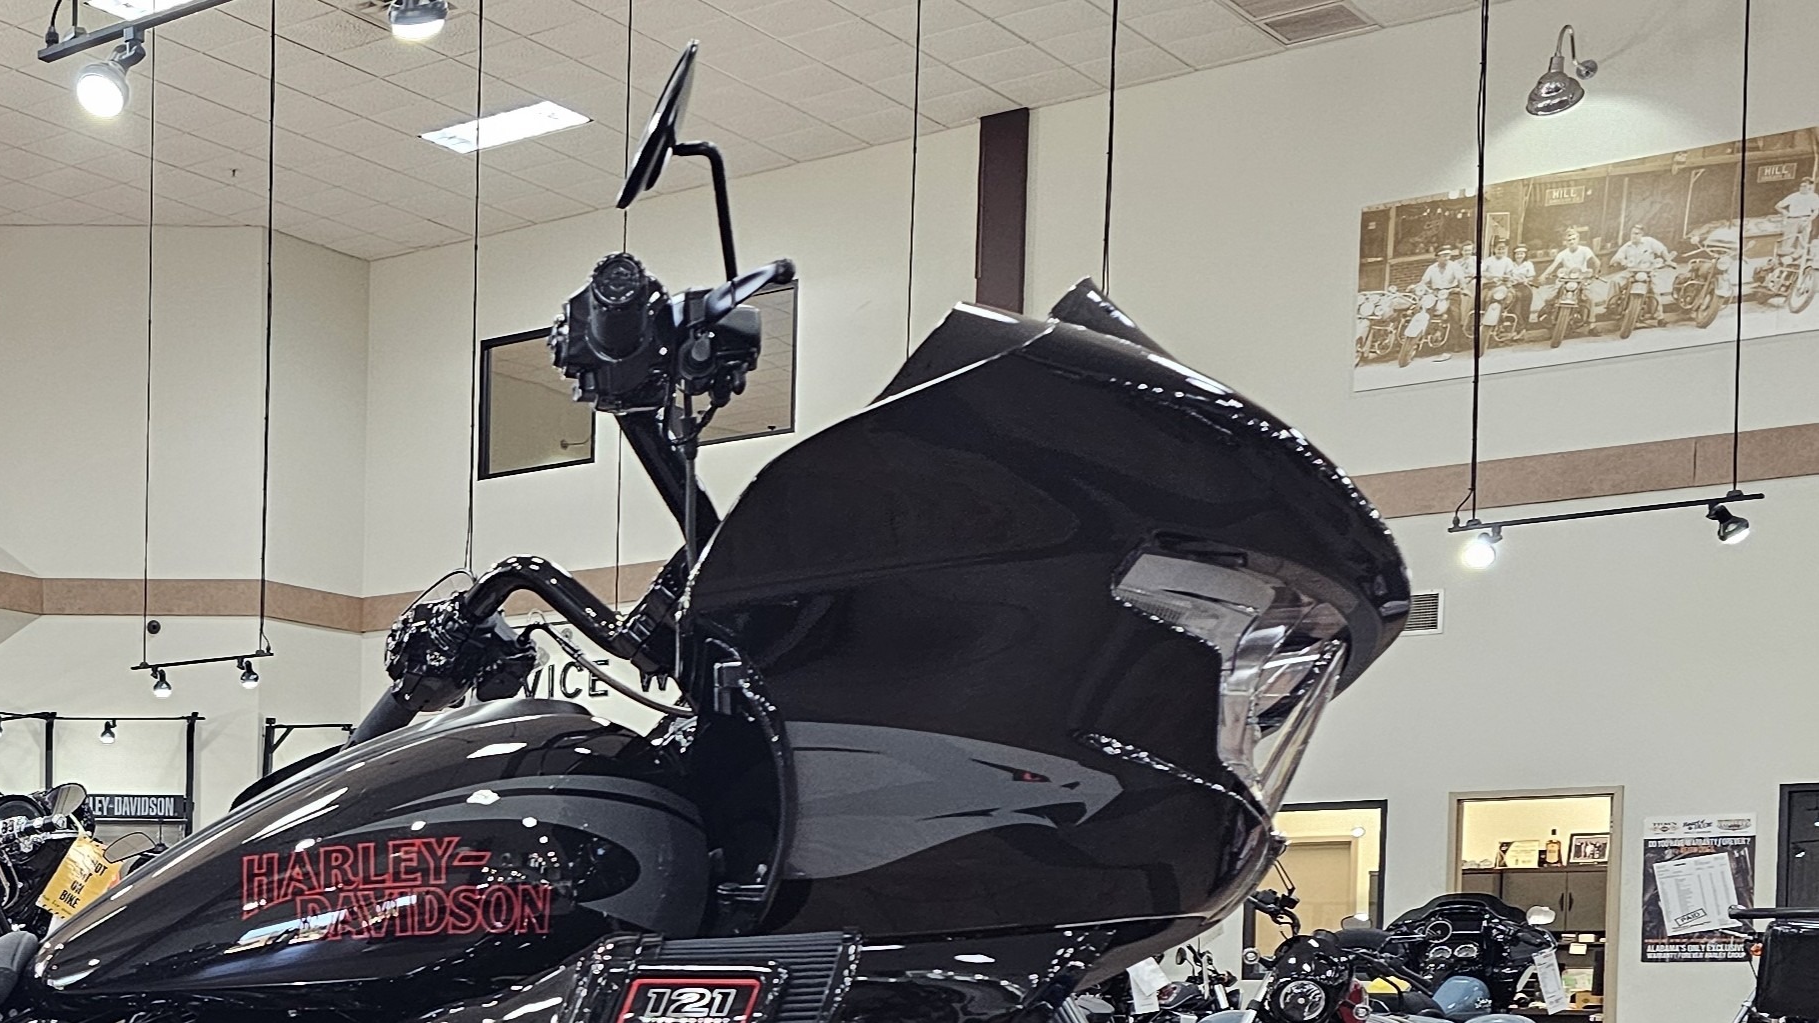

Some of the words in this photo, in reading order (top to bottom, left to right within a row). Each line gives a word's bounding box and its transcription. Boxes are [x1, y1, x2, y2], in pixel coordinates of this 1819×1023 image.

[89, 796, 174, 816] LEY-DAVIDSON
[58, 889, 81, 909] BIKE
[295, 884, 552, 941] DAVIDSON
[1680, 911, 1701, 923] PAID
[644, 987, 737, 1018] 121
